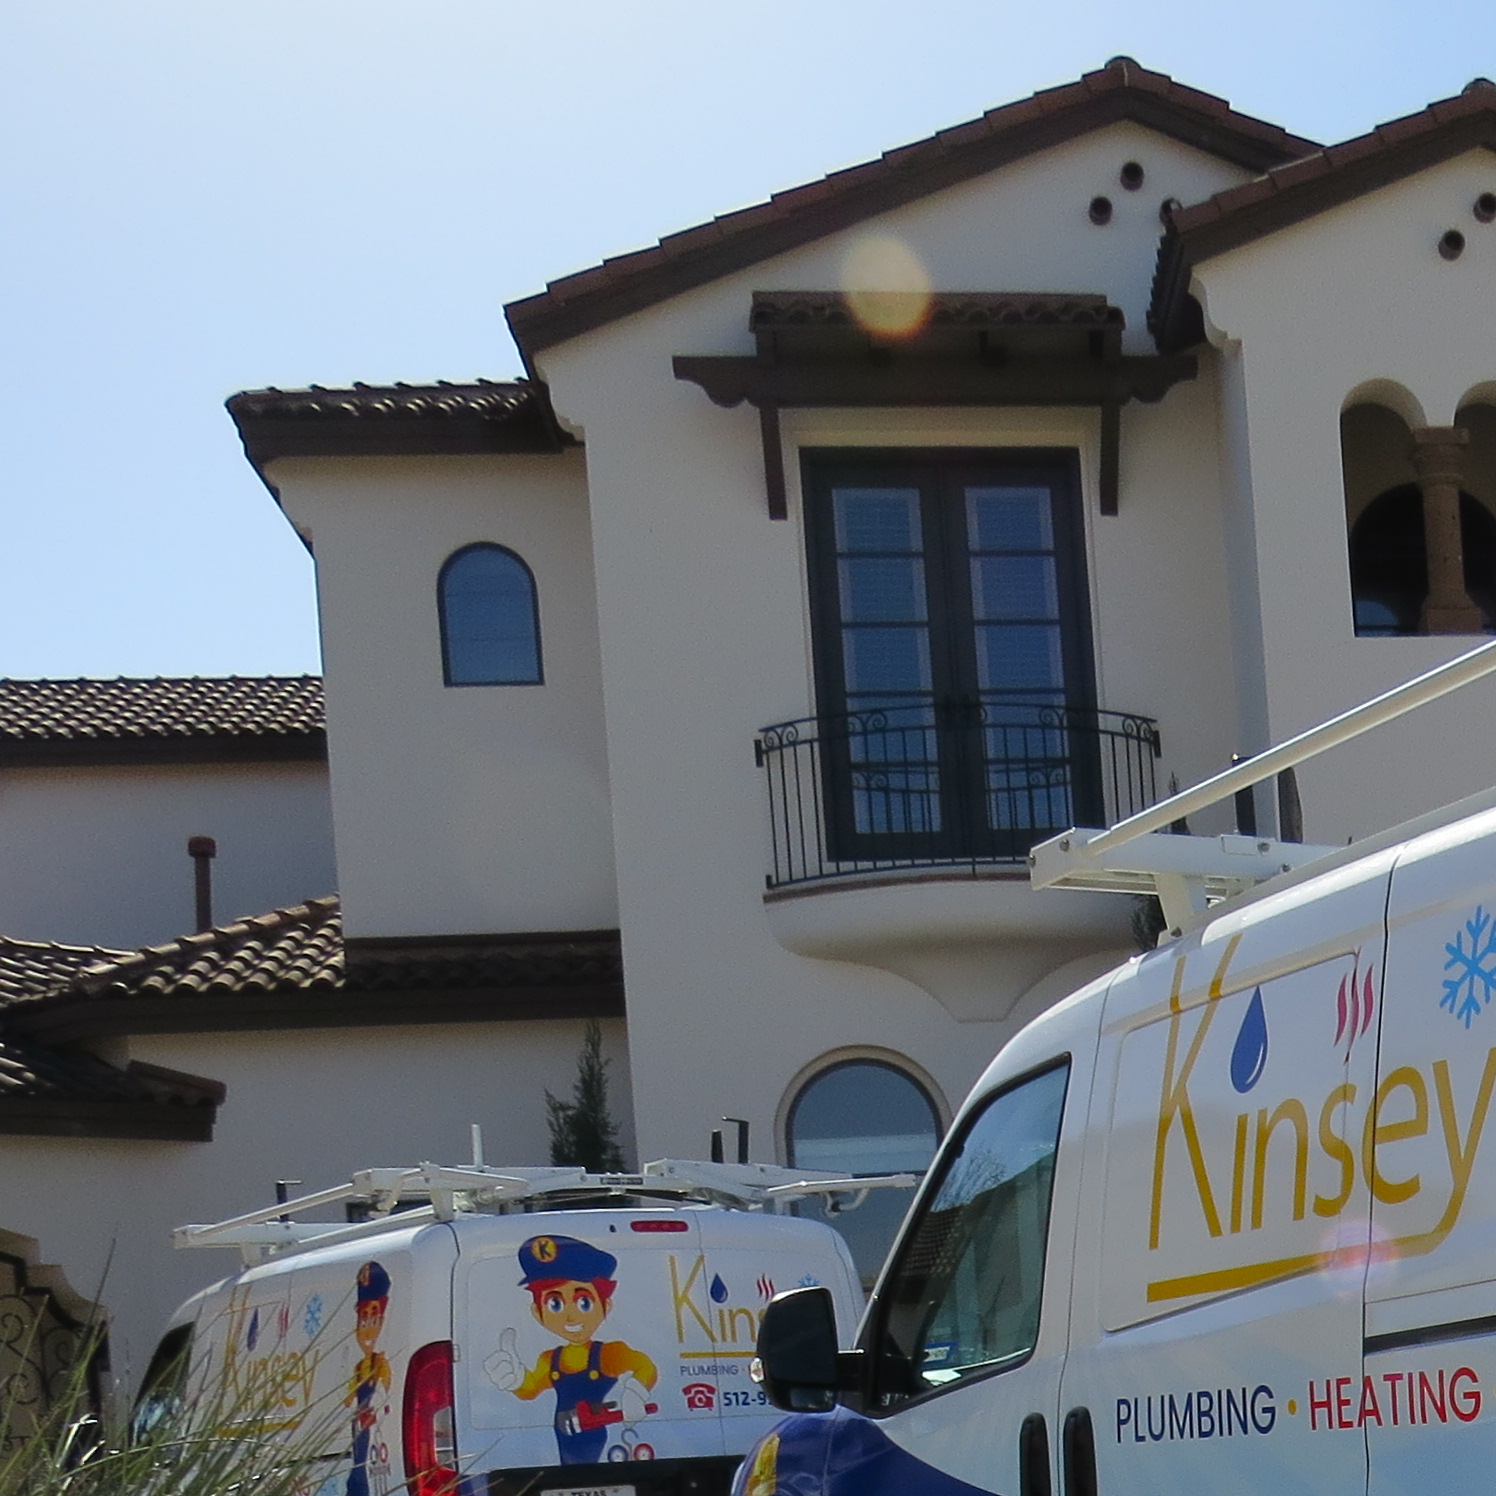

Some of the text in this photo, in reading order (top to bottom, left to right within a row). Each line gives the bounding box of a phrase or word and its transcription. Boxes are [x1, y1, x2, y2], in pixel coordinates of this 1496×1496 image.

[679, 1365, 739, 1377] PLUMBING
[1116, 1385, 1276, 1443] PLUMBING
[1309, 1367, 1482, 1431] HEATING
